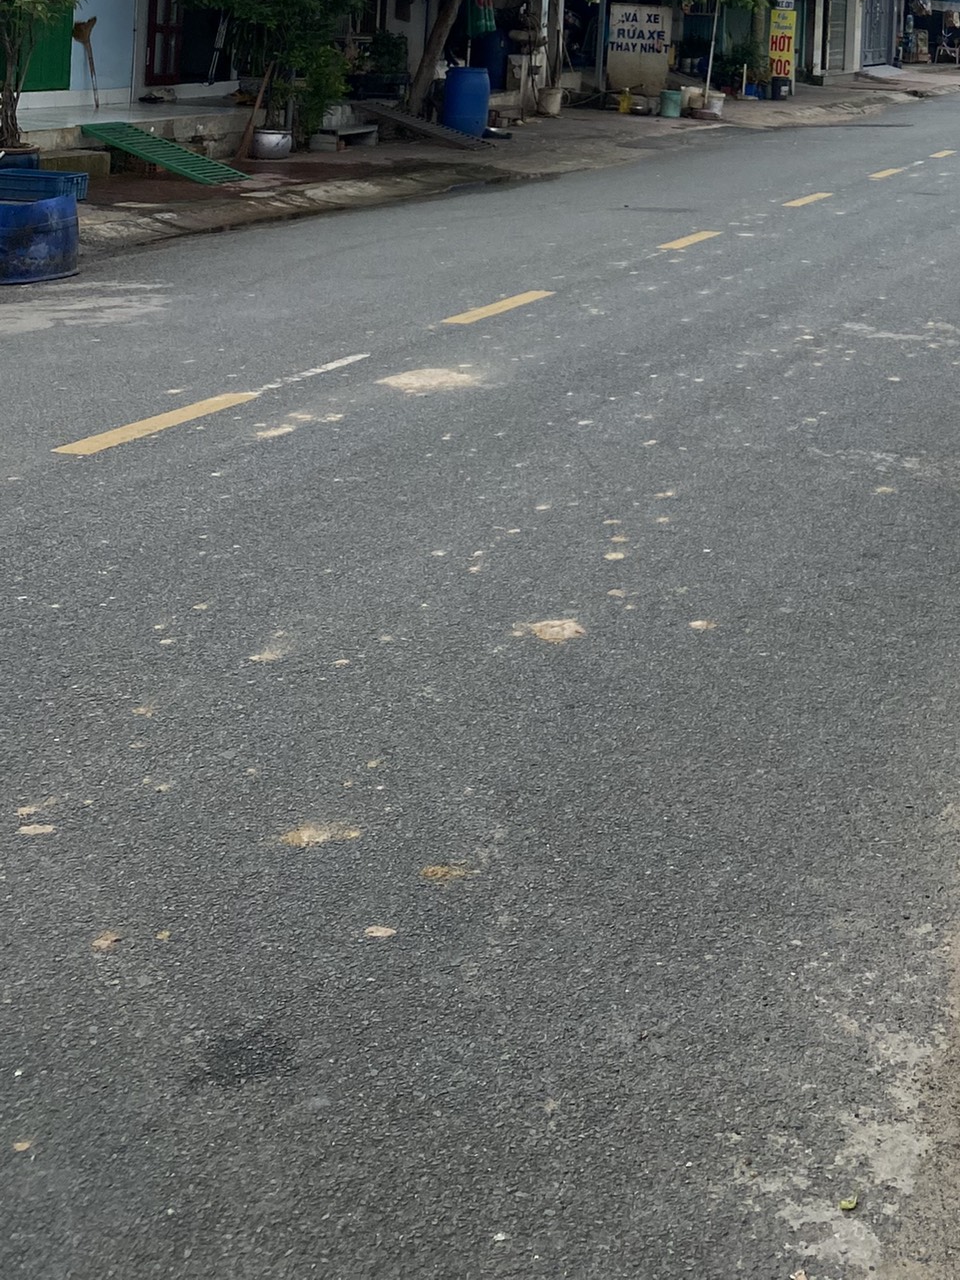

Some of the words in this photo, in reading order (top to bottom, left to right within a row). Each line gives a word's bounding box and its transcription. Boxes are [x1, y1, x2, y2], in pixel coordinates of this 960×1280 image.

[646, 13, 660, 24] XE
[647, 30, 665, 41] XE
[610, 41, 637, 52] THAY
[770, 31, 792, 52] HỚT
[770, 56, 791, 76] TÓC
